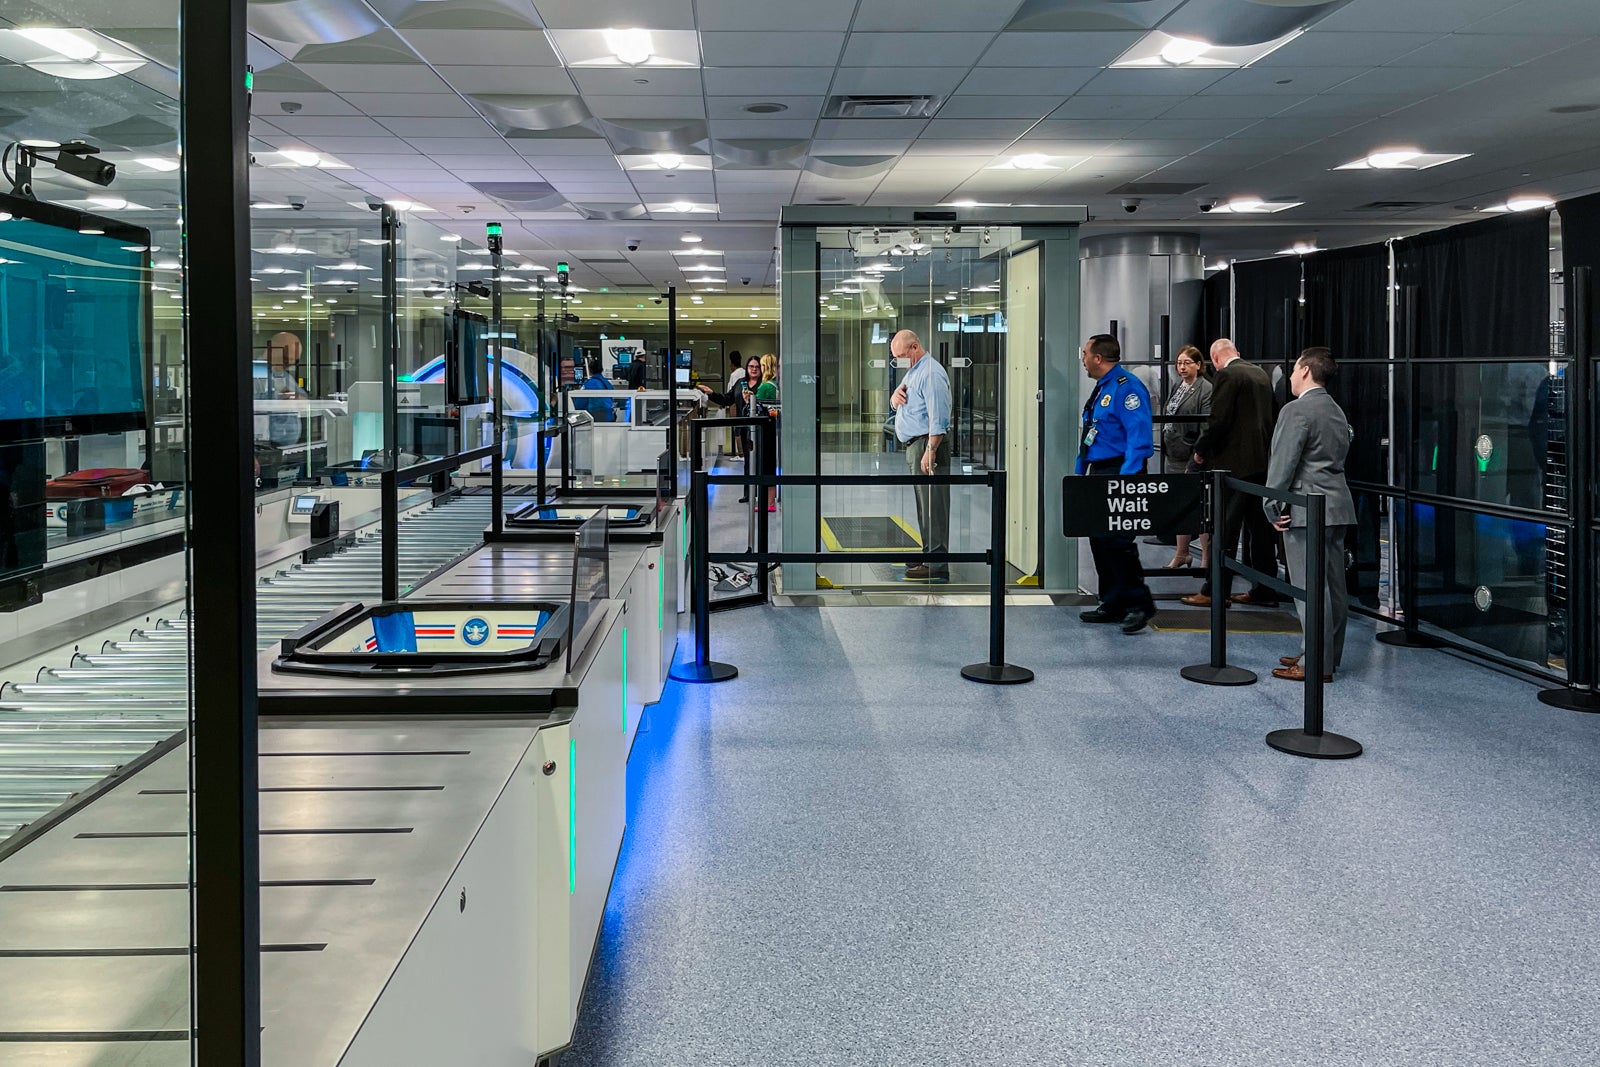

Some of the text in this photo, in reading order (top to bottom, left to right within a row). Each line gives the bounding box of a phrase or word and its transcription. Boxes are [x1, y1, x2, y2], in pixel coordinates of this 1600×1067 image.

[1107, 480, 1169, 495] Please
[1107, 497, 1149, 513] Wait
[1108, 516, 1151, 531] Here
